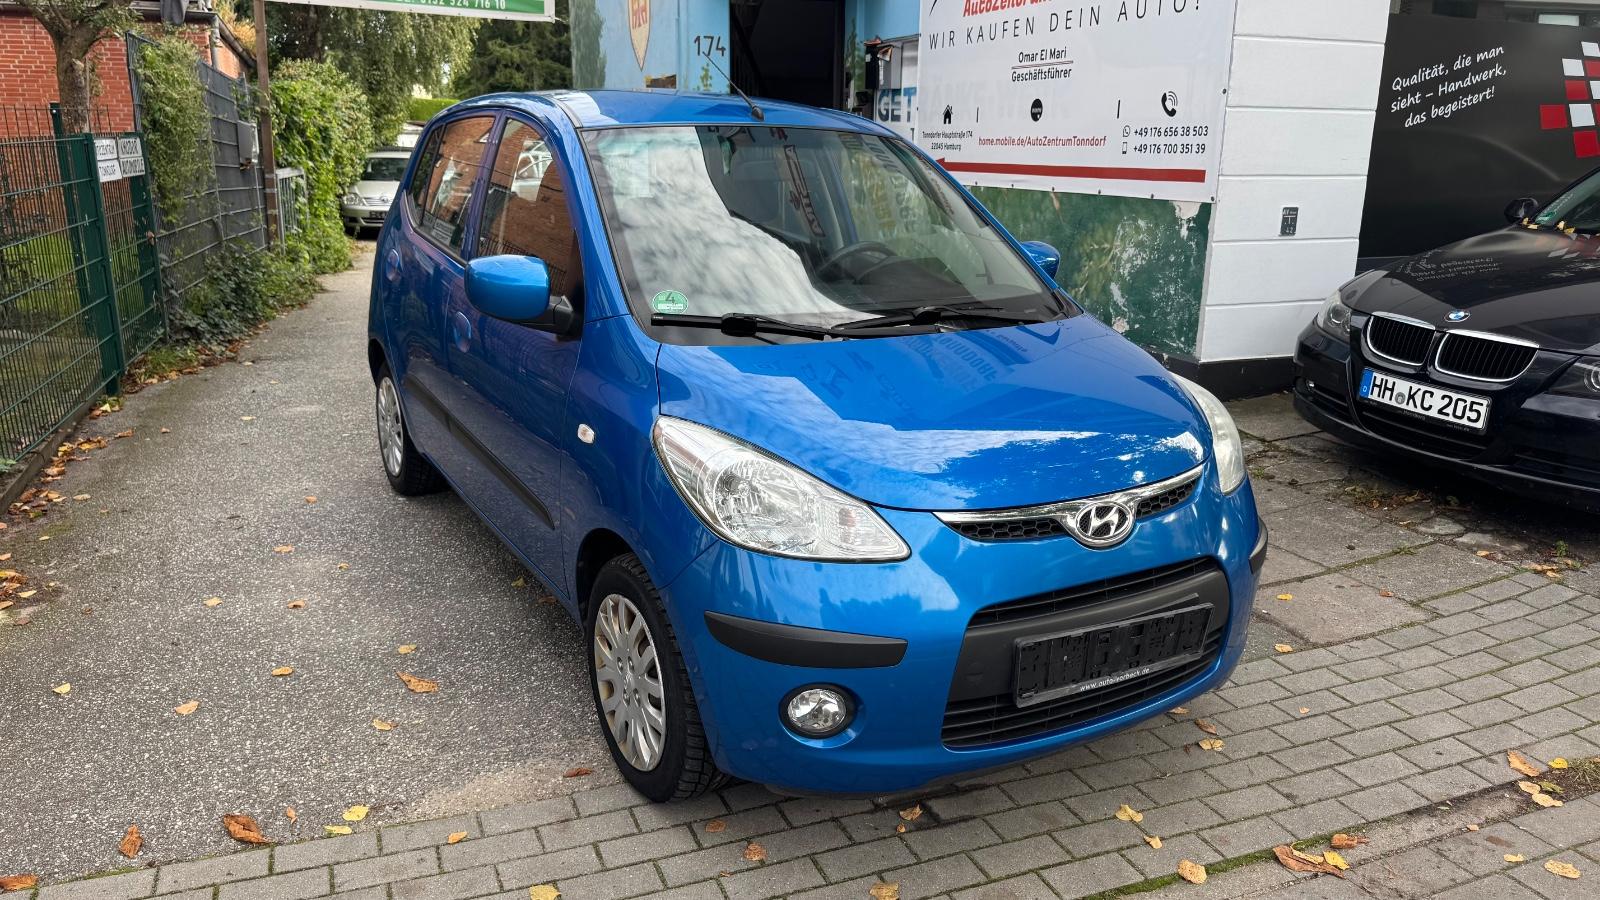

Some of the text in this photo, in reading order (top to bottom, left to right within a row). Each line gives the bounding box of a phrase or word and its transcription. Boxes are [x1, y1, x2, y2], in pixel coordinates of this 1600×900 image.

[929, 30, 955, 50] WIR
[966, 16, 1035, 45] KAUFEN
[1049, 5, 1101, 32] DEIN
[694, 35, 726, 57] 174
[1018, 46, 1067, 63] Omar El Mari
[1011, 67, 1073, 82] Geschäftsführer
[1391, 46, 1505, 91] Qualität, die man
[1390, 91, 1422, 113] sieht
[1438, 63, 1507, 97] Handwerk,
[1404, 85, 1495, 128] das begeistert!
[978, 135, 1107, 148] home.mobile.de/AutoZentrumTonndorf
[1133, 125, 1209, 138] +49 176 656 38 503
[1133, 143, 1206, 154] +49 176 700 351 39
[1370, 375, 1484, 423] HH KC 205
